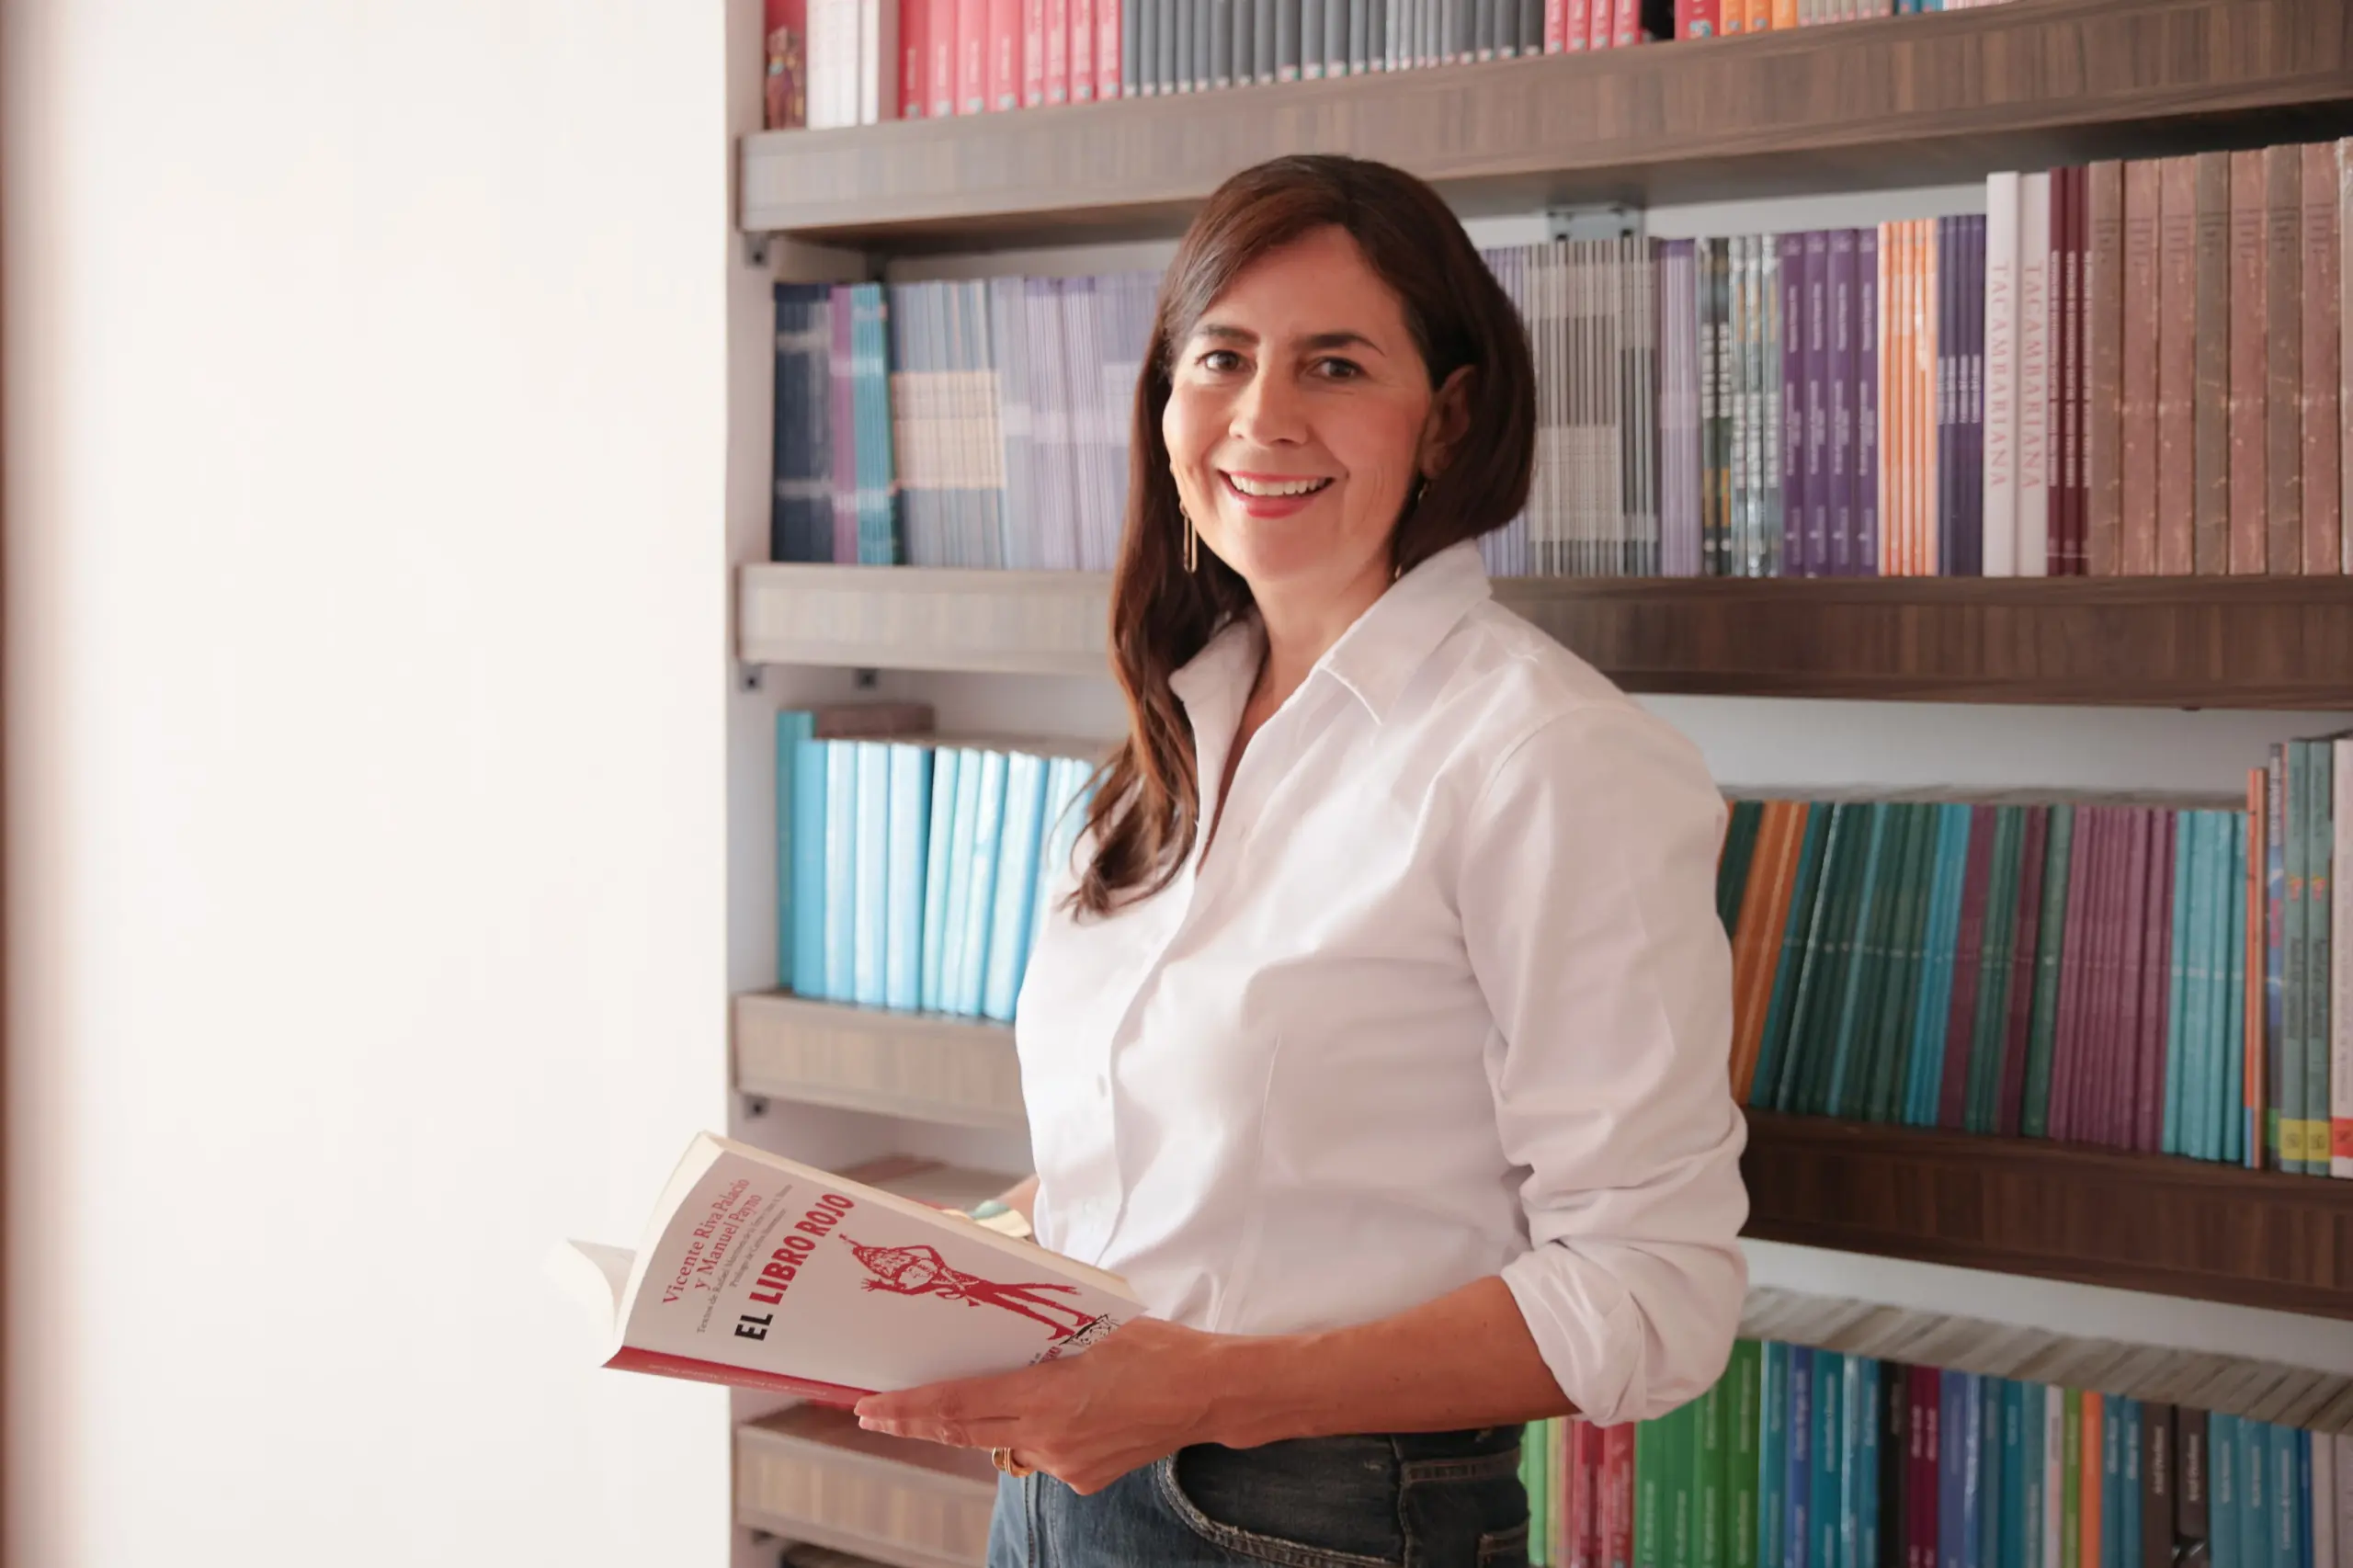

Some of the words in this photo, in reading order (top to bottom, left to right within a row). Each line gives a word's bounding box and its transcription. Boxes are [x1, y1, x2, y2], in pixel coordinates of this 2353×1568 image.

[728, 1194, 762, 1223] Payno
[794, 1194, 855, 1237] ROJO
[663, 1241, 704, 1303] Vicente
[693, 1212, 723, 1239] Riva
[711, 1178, 750, 1212] Palacio
[697, 1221, 739, 1276] Manuel
[695, 1278, 711, 1290] y
[749, 1235, 816, 1305] LIBRO
[697, 1303, 713, 1334] Textos
[734, 1313, 774, 1341] EL
